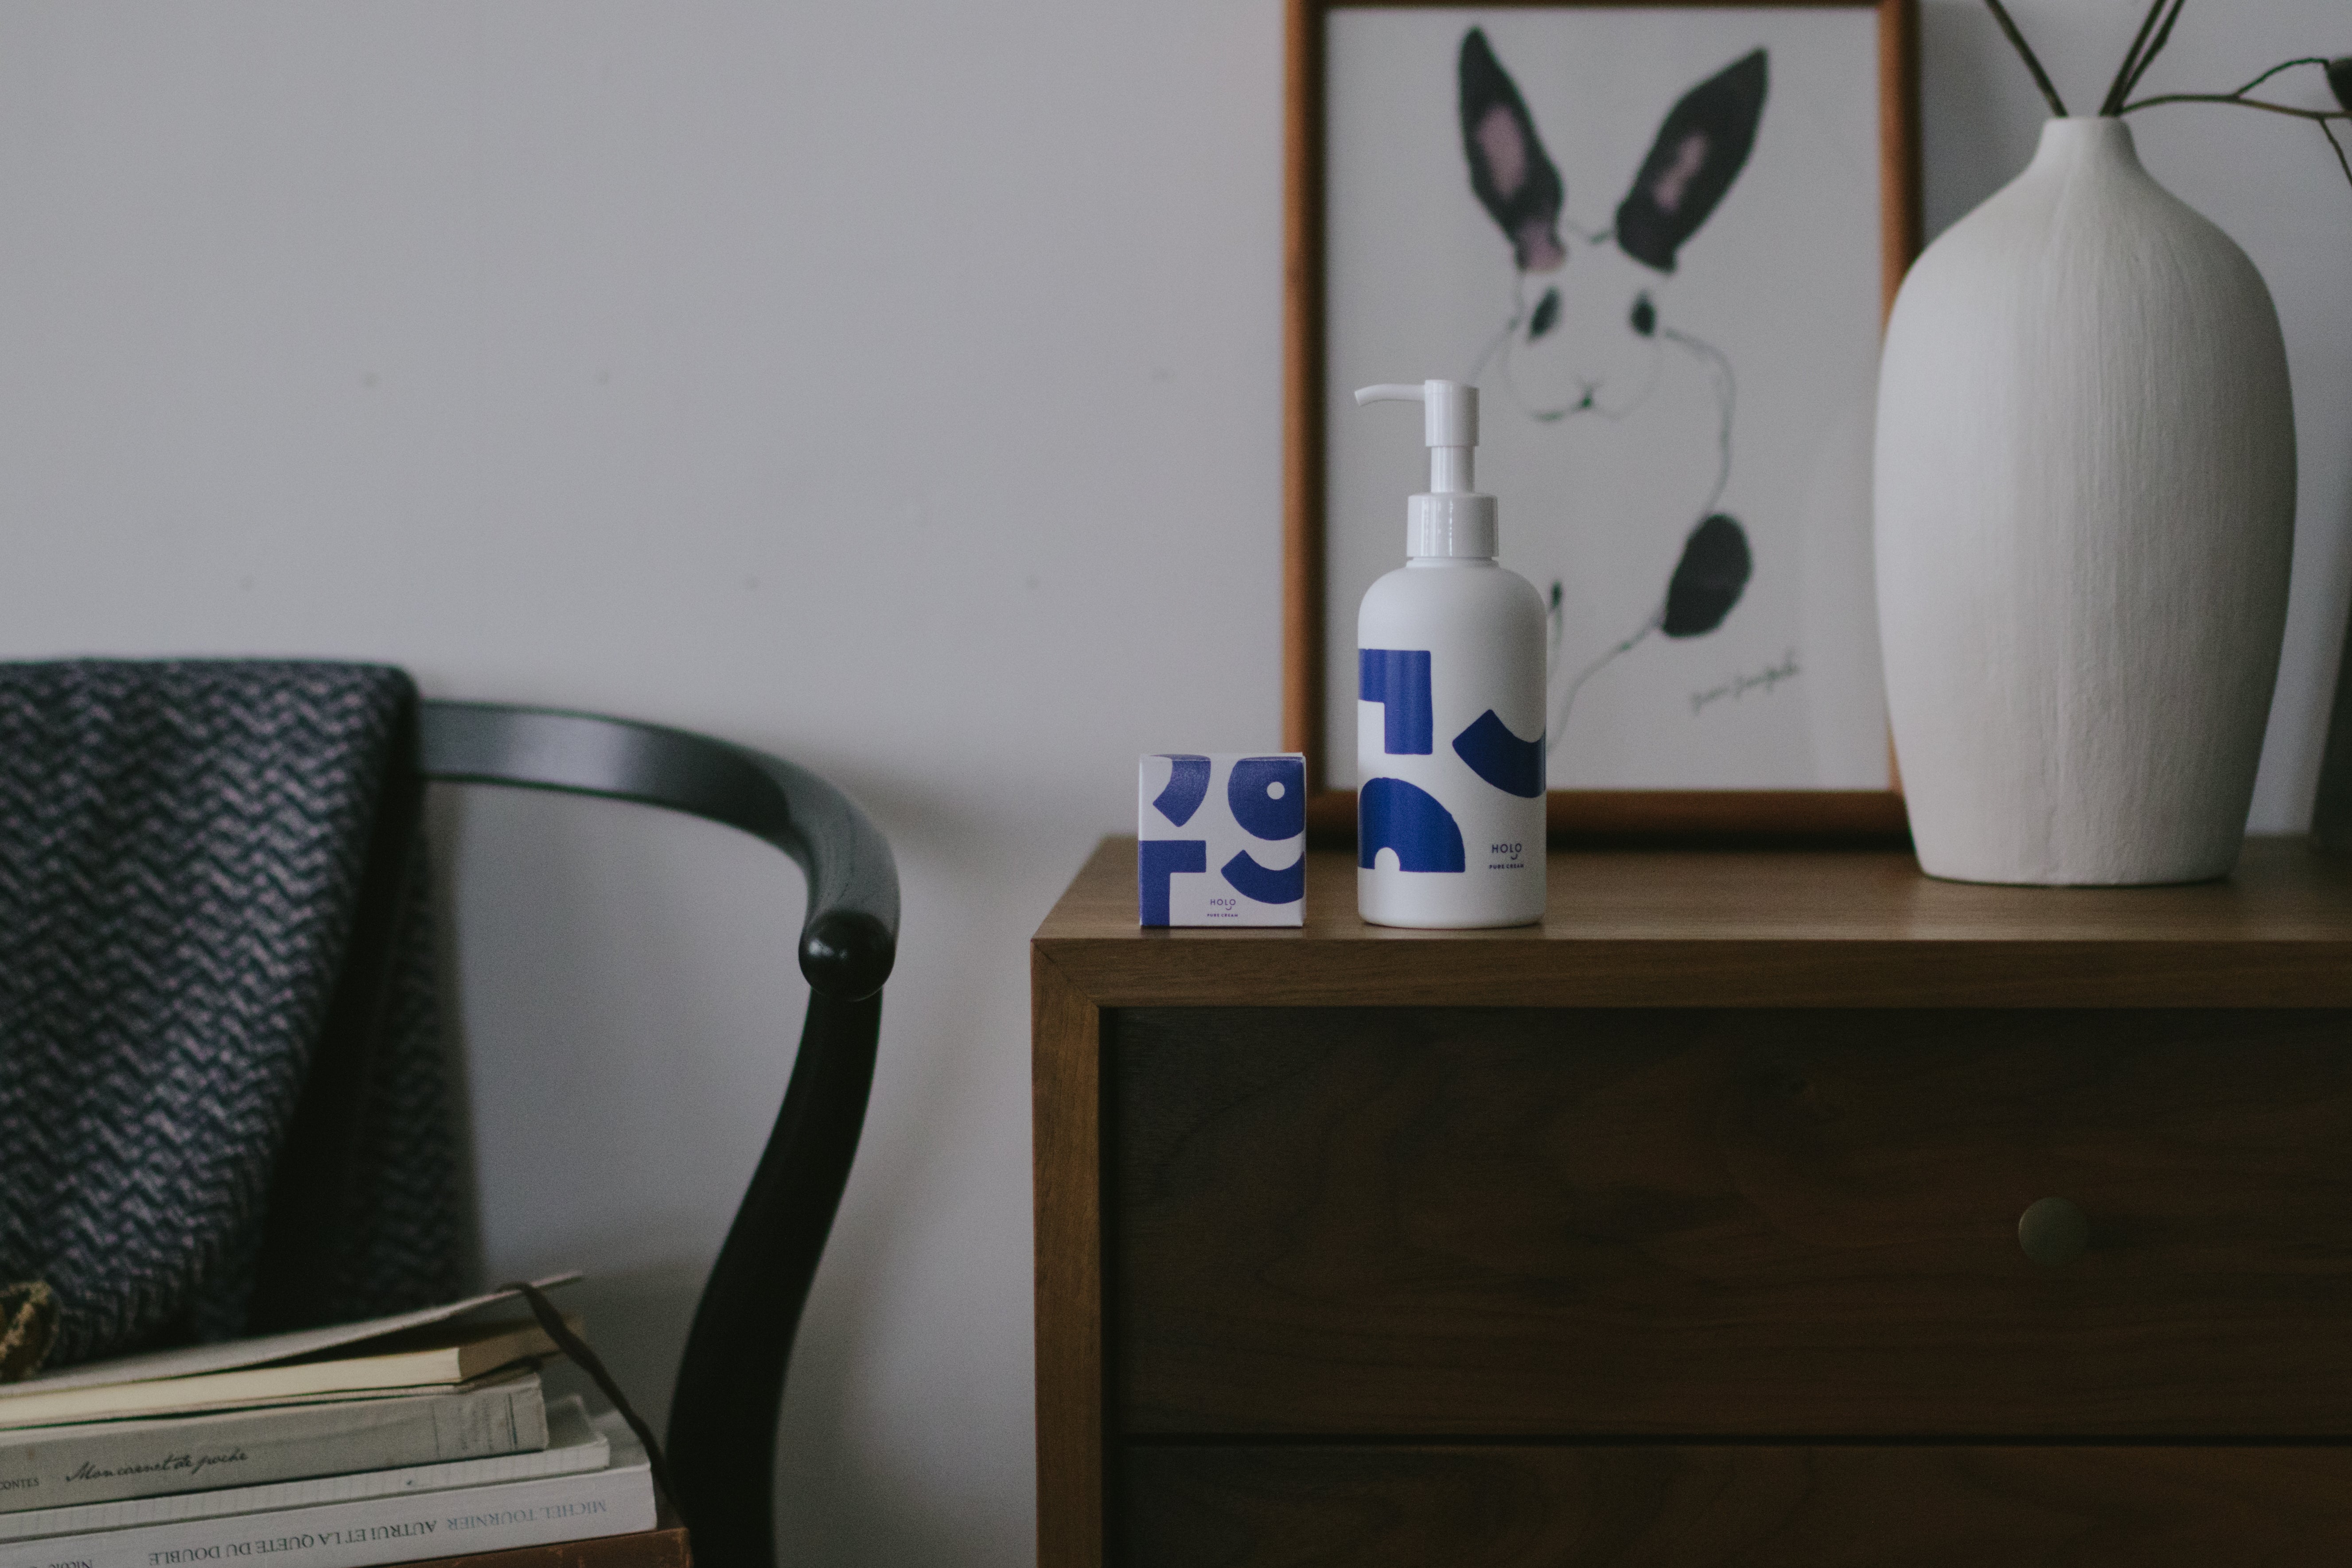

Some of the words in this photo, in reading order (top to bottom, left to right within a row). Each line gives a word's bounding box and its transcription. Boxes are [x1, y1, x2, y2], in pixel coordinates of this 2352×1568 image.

[1492, 843, 1522, 853] HOLO
[540, 1500, 607, 1519] MICHEL
[447, 1509, 538, 1531] TOURNIER
[255, 1534, 314, 1554] QUETE
[318, 1532, 341, 1545] LA
[345, 1529, 366, 1544] ET
[148, 1546, 221, 1566] DOUBLE
[226, 1542, 253, 1557] DU
